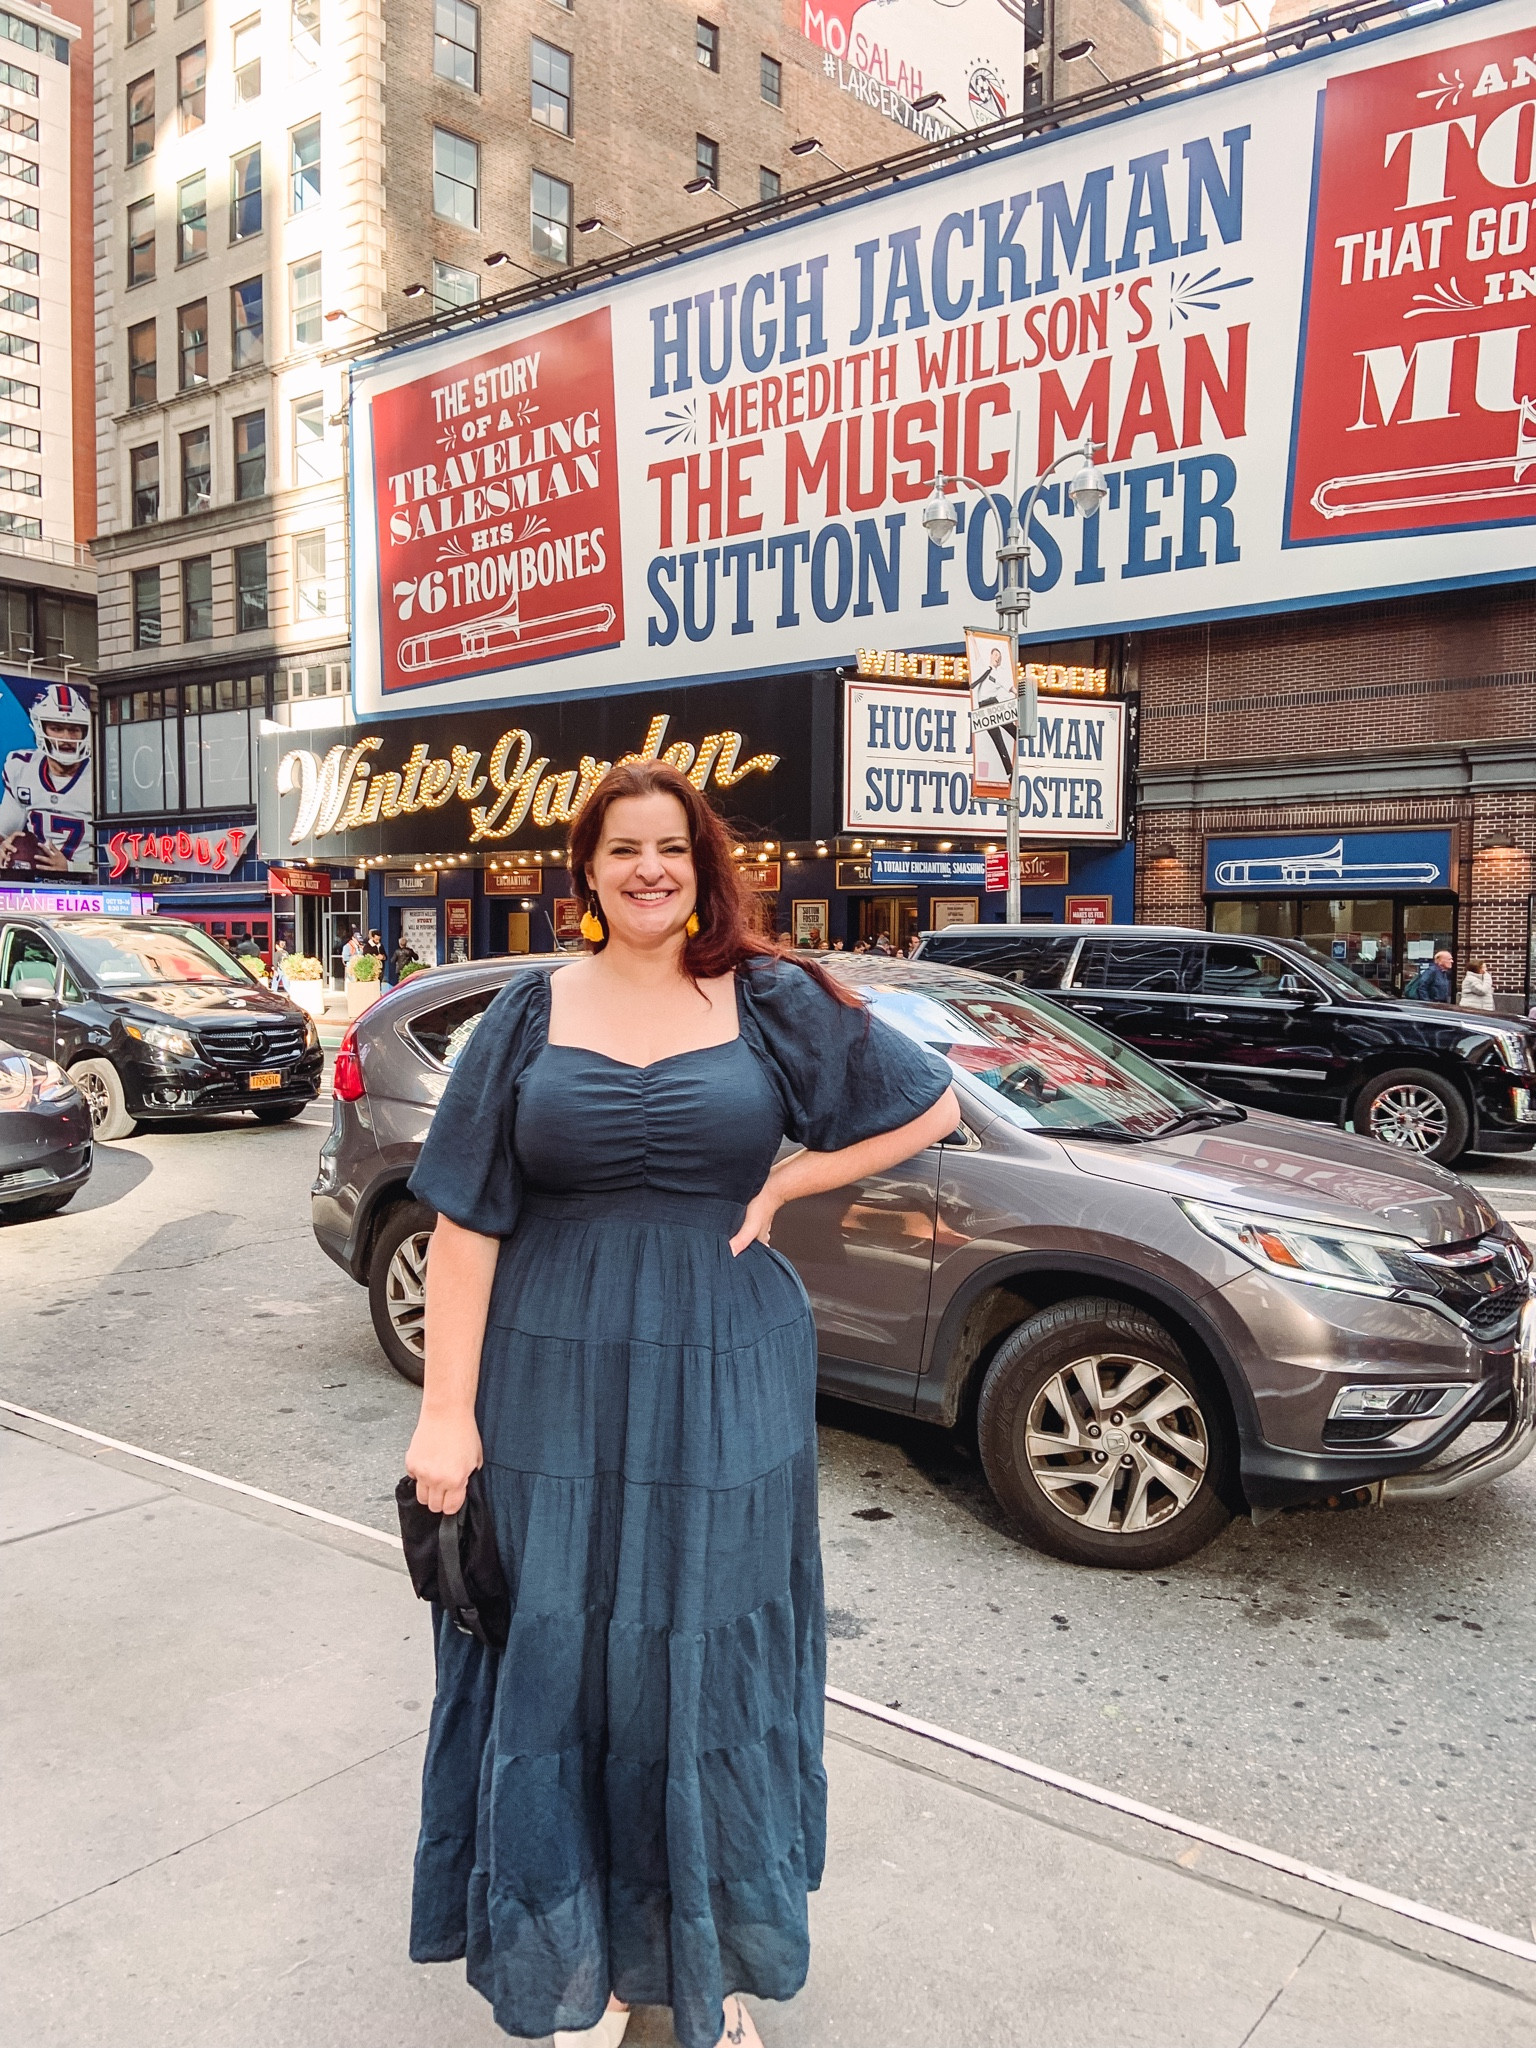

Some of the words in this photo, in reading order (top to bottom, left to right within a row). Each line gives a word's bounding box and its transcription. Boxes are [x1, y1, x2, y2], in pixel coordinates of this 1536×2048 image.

[804, 0, 847, 56] MO
[856, 32, 923, 99] SALAH
[1384, 99, 1536, 212] TO
[649, 254, 828, 398] HUGH
[850, 123, 1251, 346] JACKMAN
[1334, 216, 1453, 286] THAT
[1466, 198, 1536, 262] GO
[431, 384, 470, 424] THE
[474, 351, 541, 409] STORY
[708, 345, 898, 444] MEREDITH
[915, 277, 1153, 393] WILLSON'S
[388, 408, 601, 508] TRAVELING
[461, 414, 492, 442] OF
[497, 409, 514, 433] A
[646, 439, 765, 549] THE
[783, 382, 1011, 527] MUSIC
[1037, 322, 1251, 477] MAN
[389, 450, 601, 546] SALESMAN
[392, 570, 448, 621] 76
[447, 527, 606, 610] TROMBONES
[471, 522, 514, 553] HIS
[646, 513, 902, 647] SUTTON
[921, 453, 1241, 608] FOSTER
[1018, 662, 1108, 695] RDEN
[867, 704, 957, 753] HUGH
[973, 708, 1018, 730] MORMON
[133, 733, 249, 789] CAPEZ
[277, 736, 487, 845] Winter
[996, 774, 1104, 820] OSTER
[27, 810, 85, 862] 17
[109, 827, 246, 878] STARDUST
[883, 861, 910, 873] TOTALLY
[57, 898, 100, 911] ELIAS
